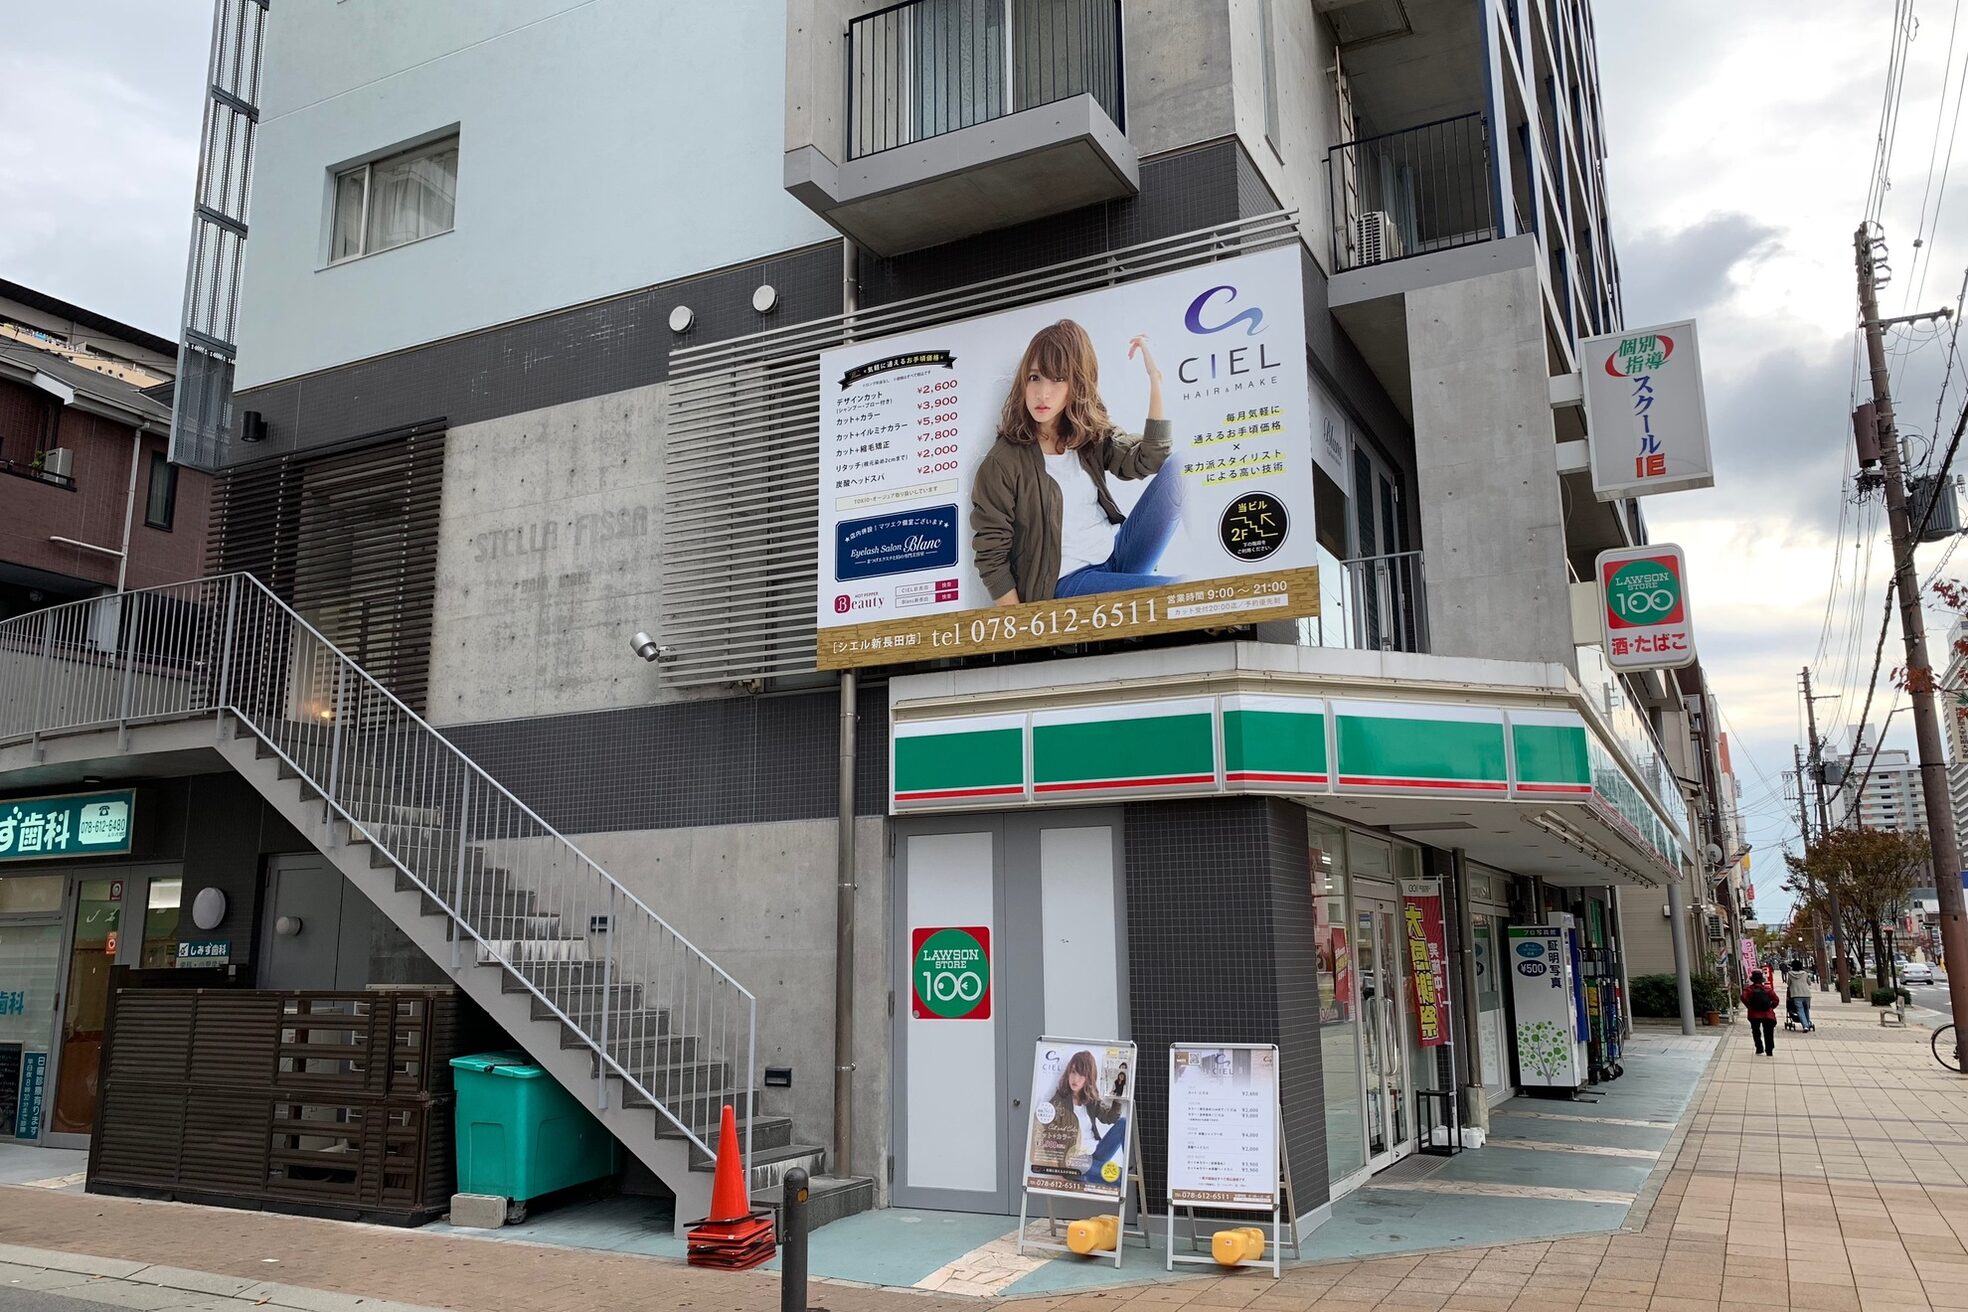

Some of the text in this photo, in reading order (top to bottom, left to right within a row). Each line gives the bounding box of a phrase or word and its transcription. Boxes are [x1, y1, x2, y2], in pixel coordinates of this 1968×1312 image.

[1618, 334, 1656, 358] 個別
[1178, 343, 1281, 384] CIEL
[1625, 350, 1664, 375] 指導
[836, 379, 958, 407] デザインカット ¥2,600
[917, 395, 958, 410] ¥3,900
[917, 411, 958, 426] ¥5,900
[1226, 405, 1281, 422] 毎月気軽に
[1632, 375, 1662, 456] スクール
[917, 427, 958, 442] ¥7,800
[1193, 420, 1282, 444] 通えるお手頃価格
[917, 444, 958, 459] ¥2,000
[1184, 449, 1282, 474] 実力派スタイリスト
[1635, 452, 1666, 478] IE
[835, 460, 958, 488] 炭酸ヘッドスパ ¥2,000
[1206, 461, 1284, 483] による高い技術
[1237, 500, 1268, 513] 当ビル
[1231, 527, 1249, 542] 2F
[850, 534, 941, 559] Eyelash Salon Blanc
[1615, 572, 1669, 586] LAWSON
[1627, 582, 1658, 591] STORE
[1166, 592, 1205, 604] 営業時間
[1207, 587, 1234, 600] 9:00
[1253, 580, 1288, 594] 21:00
[836, 596, 885, 612] Beauty
[1616, 589, 1674, 615] 100
[931, 623, 961, 648] tel
[970, 598, 1158, 643] 078-612-6511
[80, 818, 126, 834] 078-612-6480
[190, 942, 227, 956] しみず歯科
[923, 949, 979, 961] LAWSON
[935, 960, 967, 969] STORE
[1520, 963, 1544, 974] ¥500
[1547, 940, 1562, 989] 証明写真
[922, 971, 982, 1002] 100
[1212, 1067, 1234, 1075] CIEL
[1036, 1180, 1081, 1190] 078-612-6511
[1182, 1191, 1230, 1200] 078-612-6511
